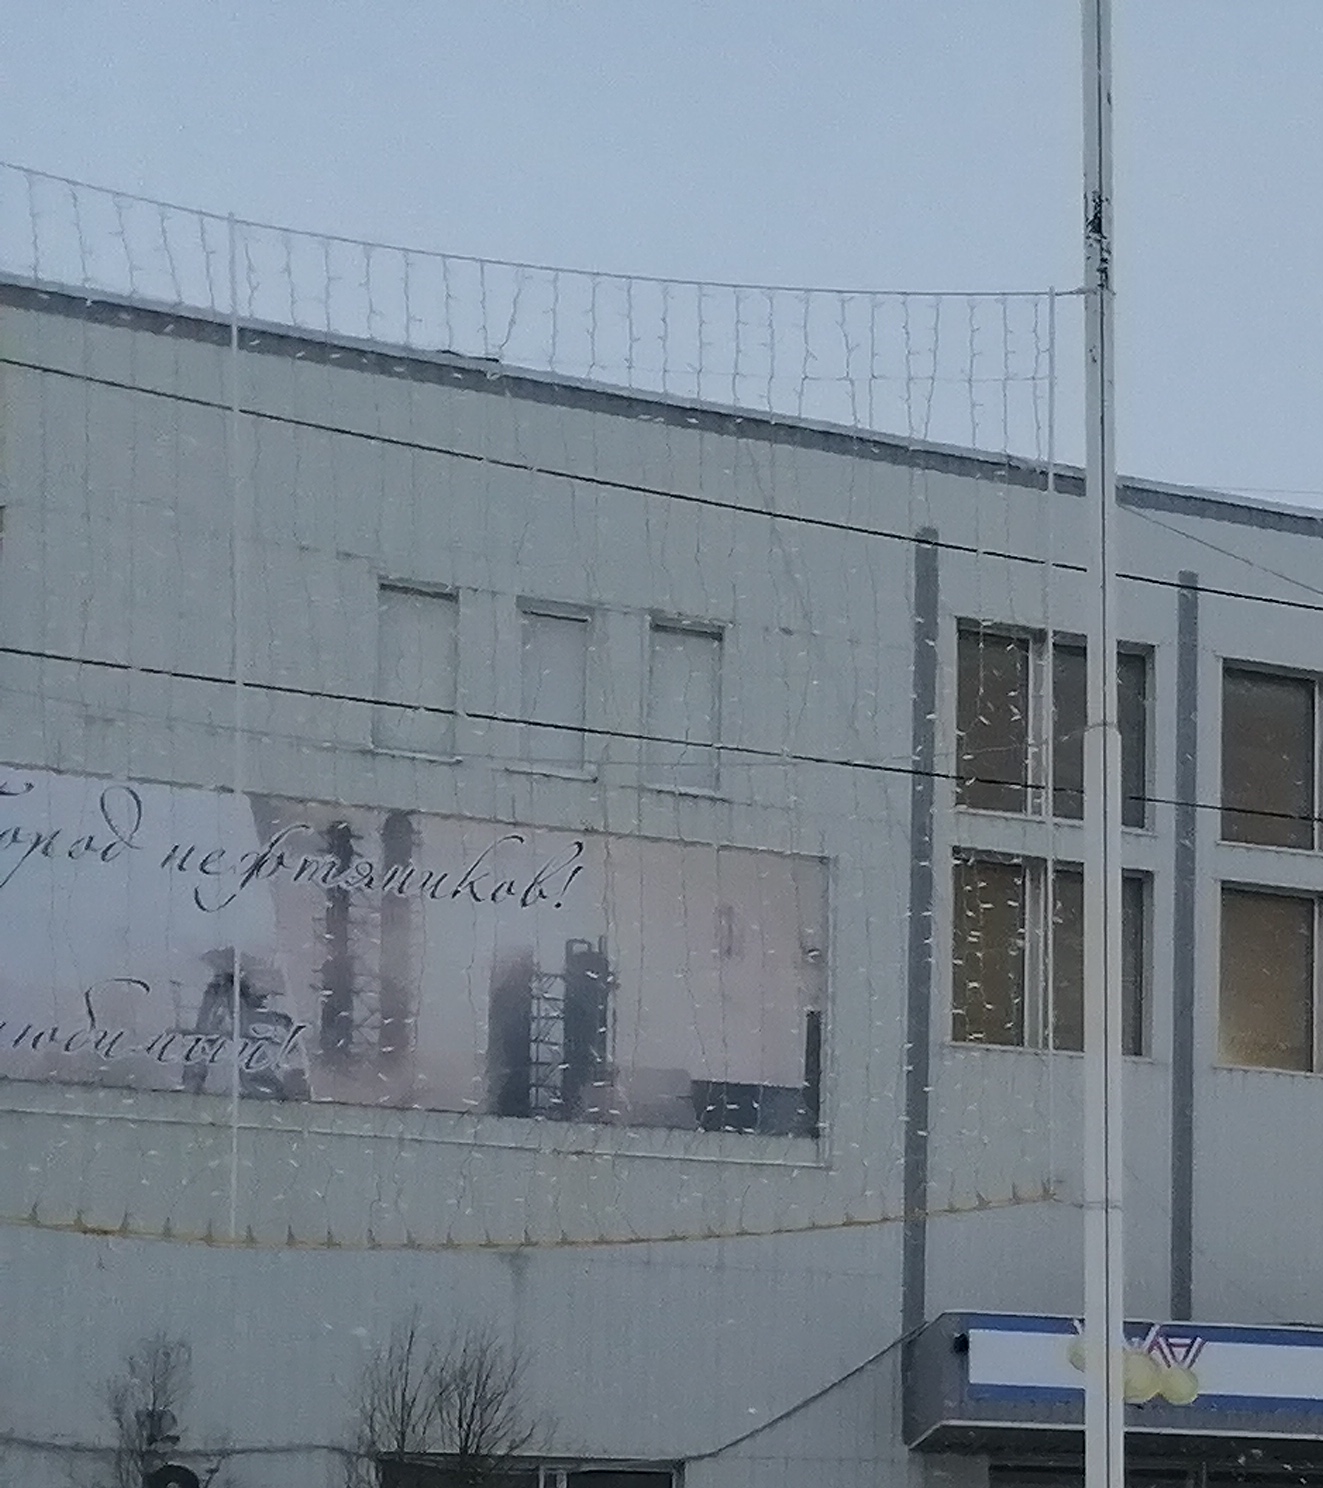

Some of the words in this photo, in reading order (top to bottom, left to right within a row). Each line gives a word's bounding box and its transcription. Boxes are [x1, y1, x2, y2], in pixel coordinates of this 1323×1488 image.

[0, 781, 147, 889] ород
[160, 822, 584, 913] нефтяников!
[0, 978, 308, 1071] юбимый!
